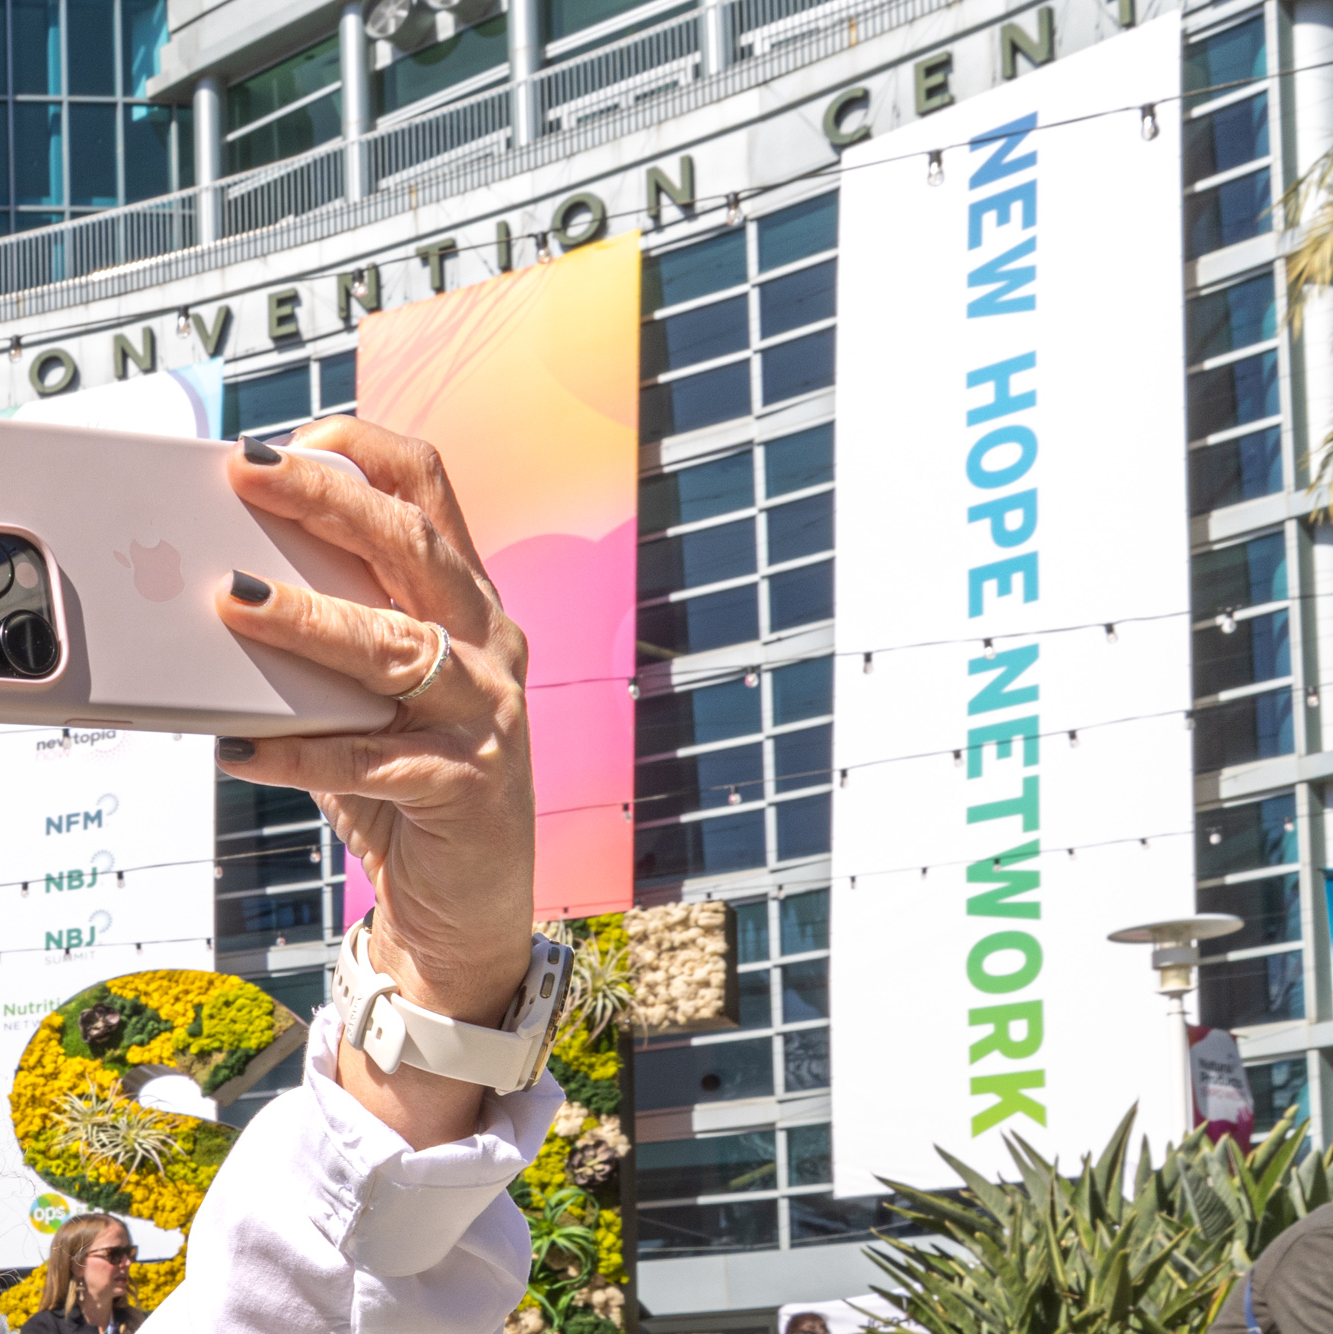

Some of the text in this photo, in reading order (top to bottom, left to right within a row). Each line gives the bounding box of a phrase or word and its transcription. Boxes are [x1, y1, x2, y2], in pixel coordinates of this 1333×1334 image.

[823, 0, 1133, 146] CEN
[966, 111, 1047, 1139] NEW HOPE NETWORK
[45, 809, 102, 836] NFM
[45, 866, 97, 893] NBJ
[44, 925, 96, 951] NBJ
[3, 998, 61, 1017] Nutriti
[3, 1020, 42, 1032] NETW
[34, 1205, 67, 1226] ops
